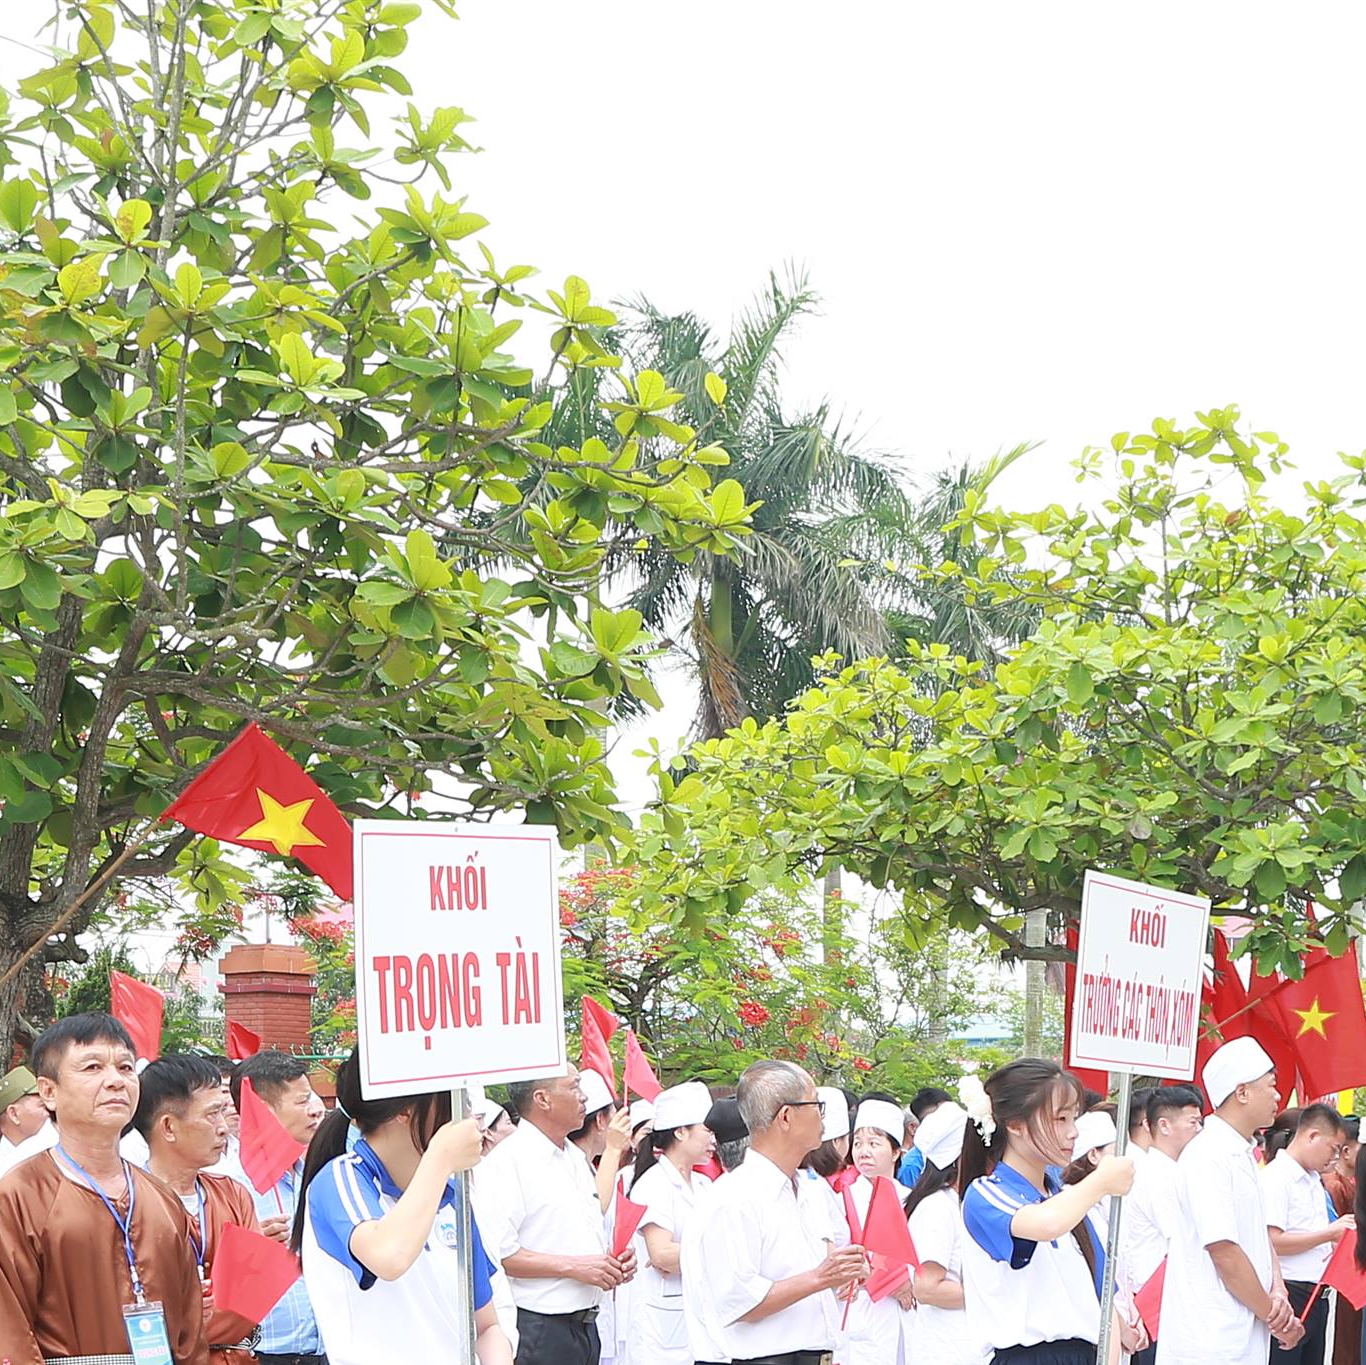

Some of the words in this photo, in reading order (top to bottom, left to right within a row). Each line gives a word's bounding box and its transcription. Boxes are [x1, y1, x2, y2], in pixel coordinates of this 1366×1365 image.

[429, 850, 488, 911] KHỐI
[1129, 904, 1167, 949] KHỐI
[373, 951, 483, 1050] TRỌNG
[496, 936, 541, 1026] TÀI
[1121, 971, 1143, 1042] CÁC
